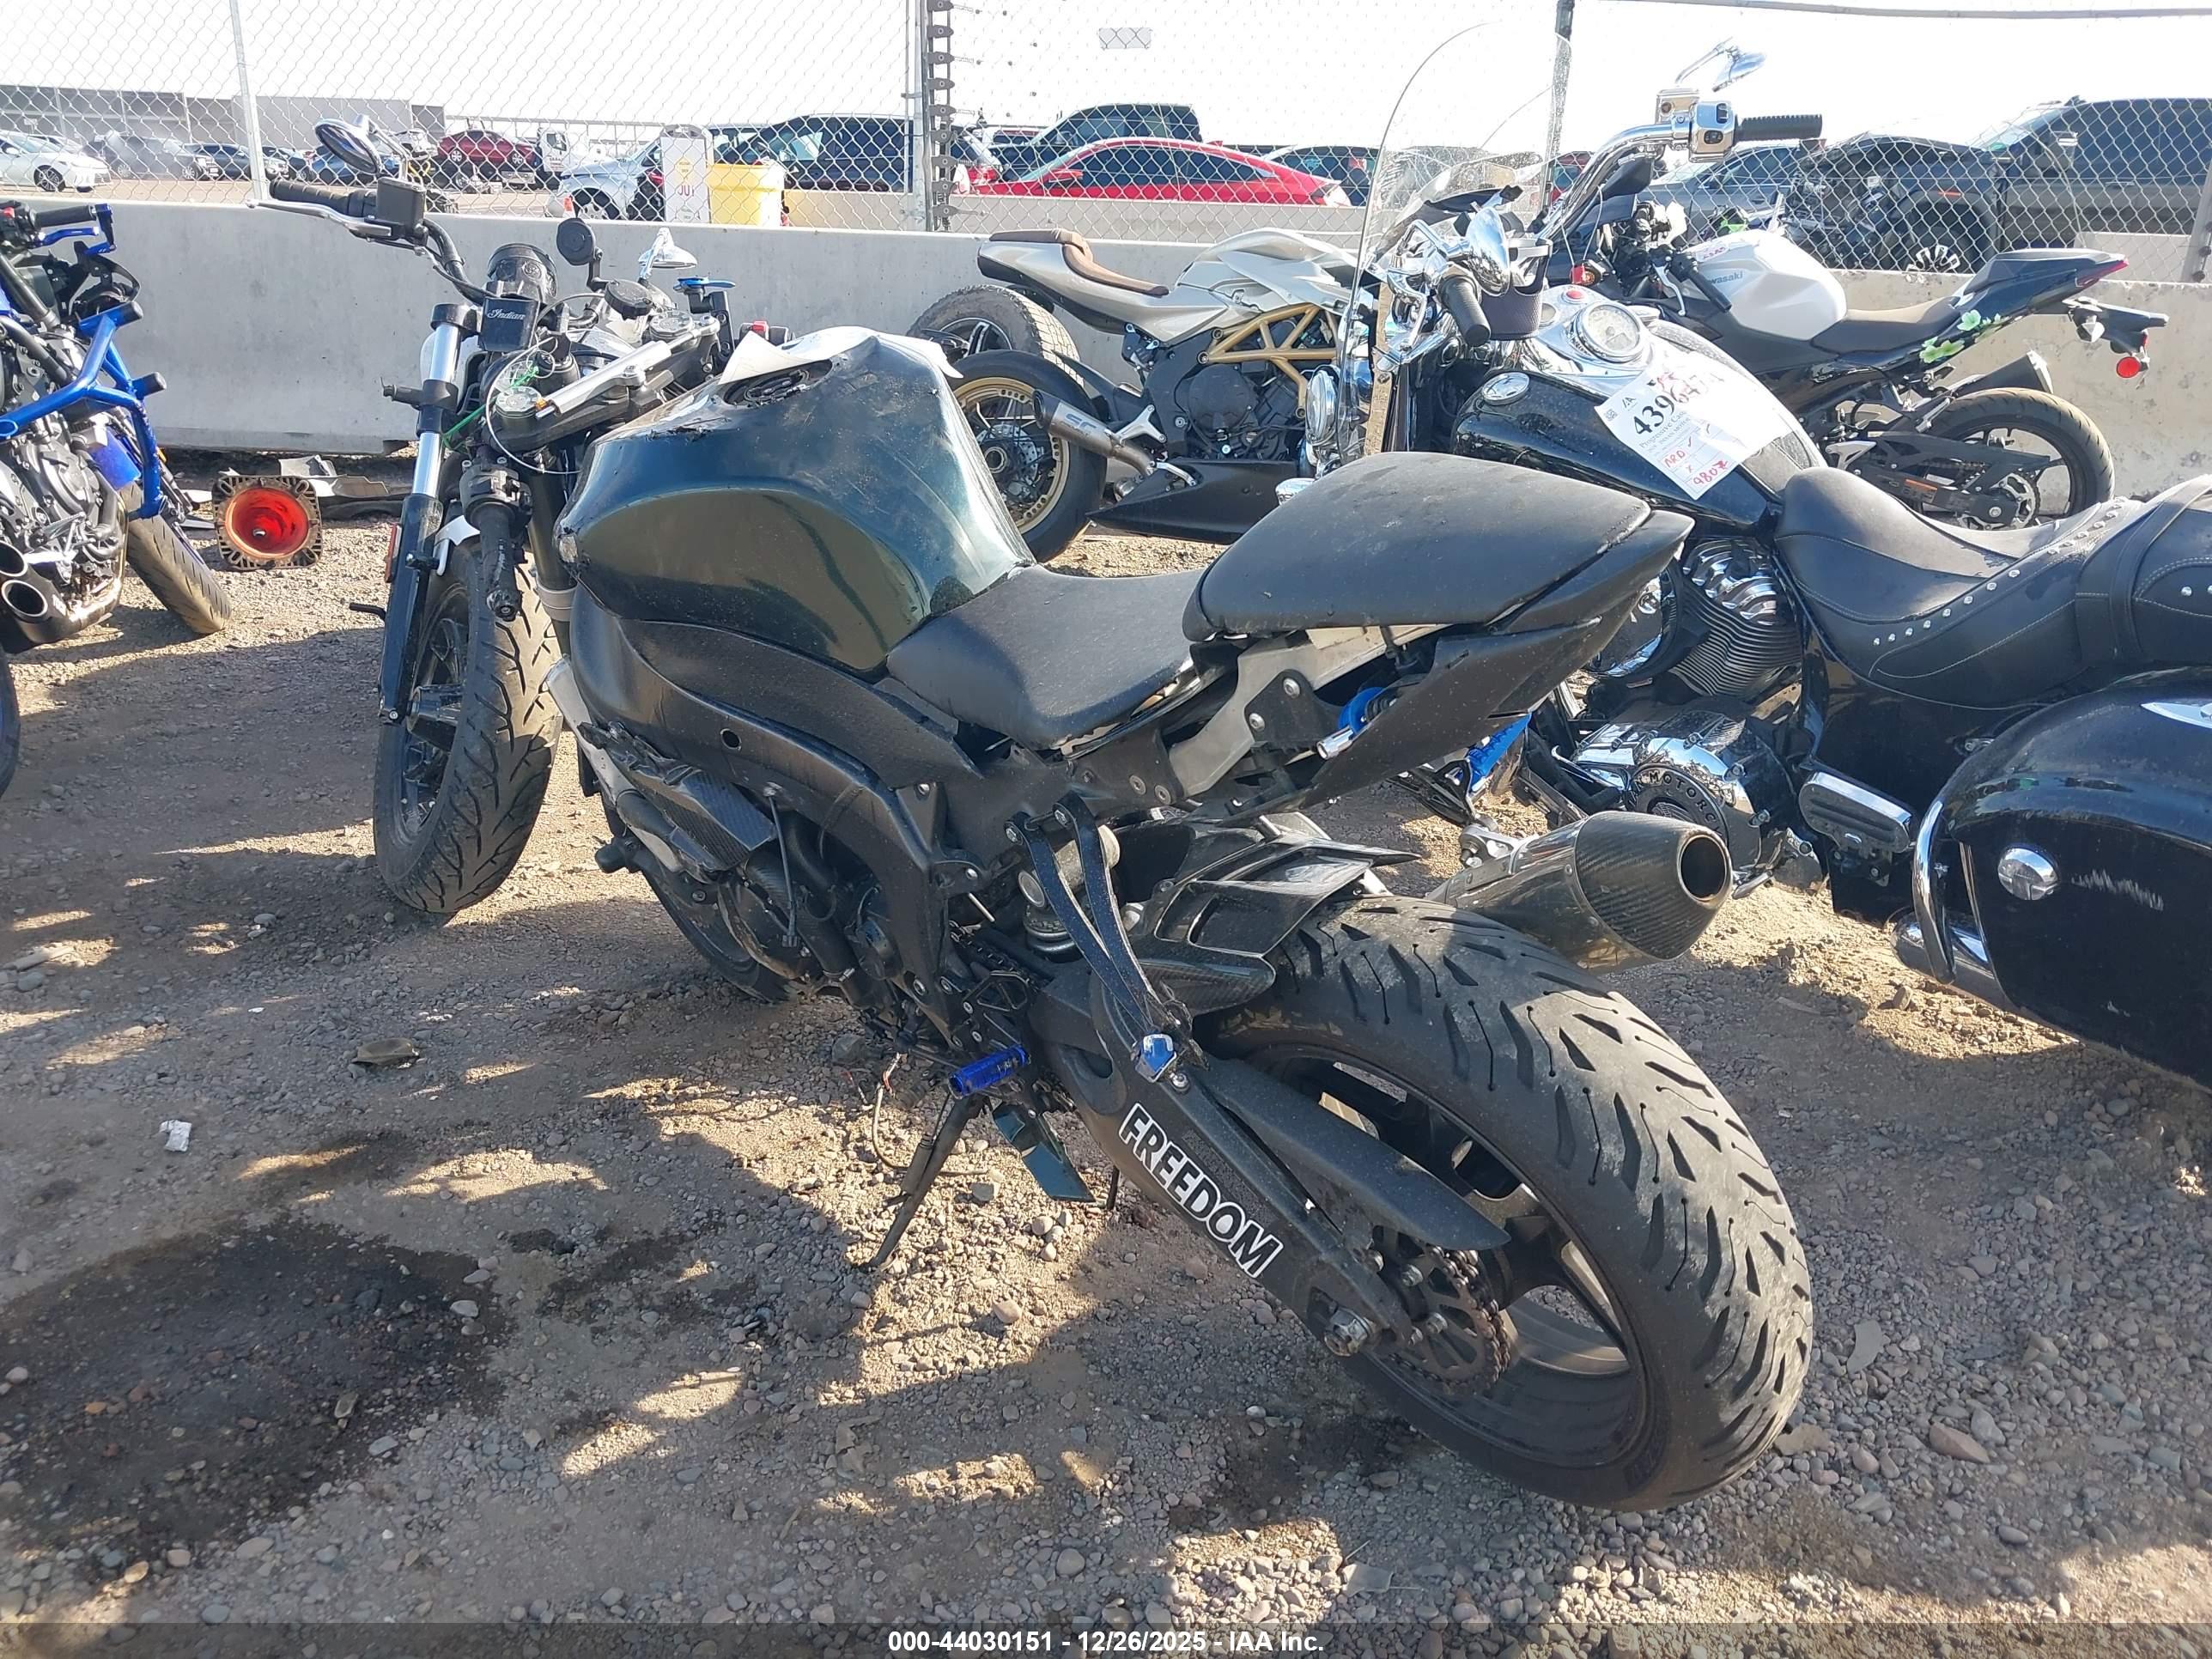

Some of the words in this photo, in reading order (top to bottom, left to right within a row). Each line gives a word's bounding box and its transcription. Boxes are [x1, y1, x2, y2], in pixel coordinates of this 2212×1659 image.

[1709, 270, 1743, 284] wasaki
[487, 308, 526, 320] Indian
[1119, 1103, 1284, 1278] FREEDOM
